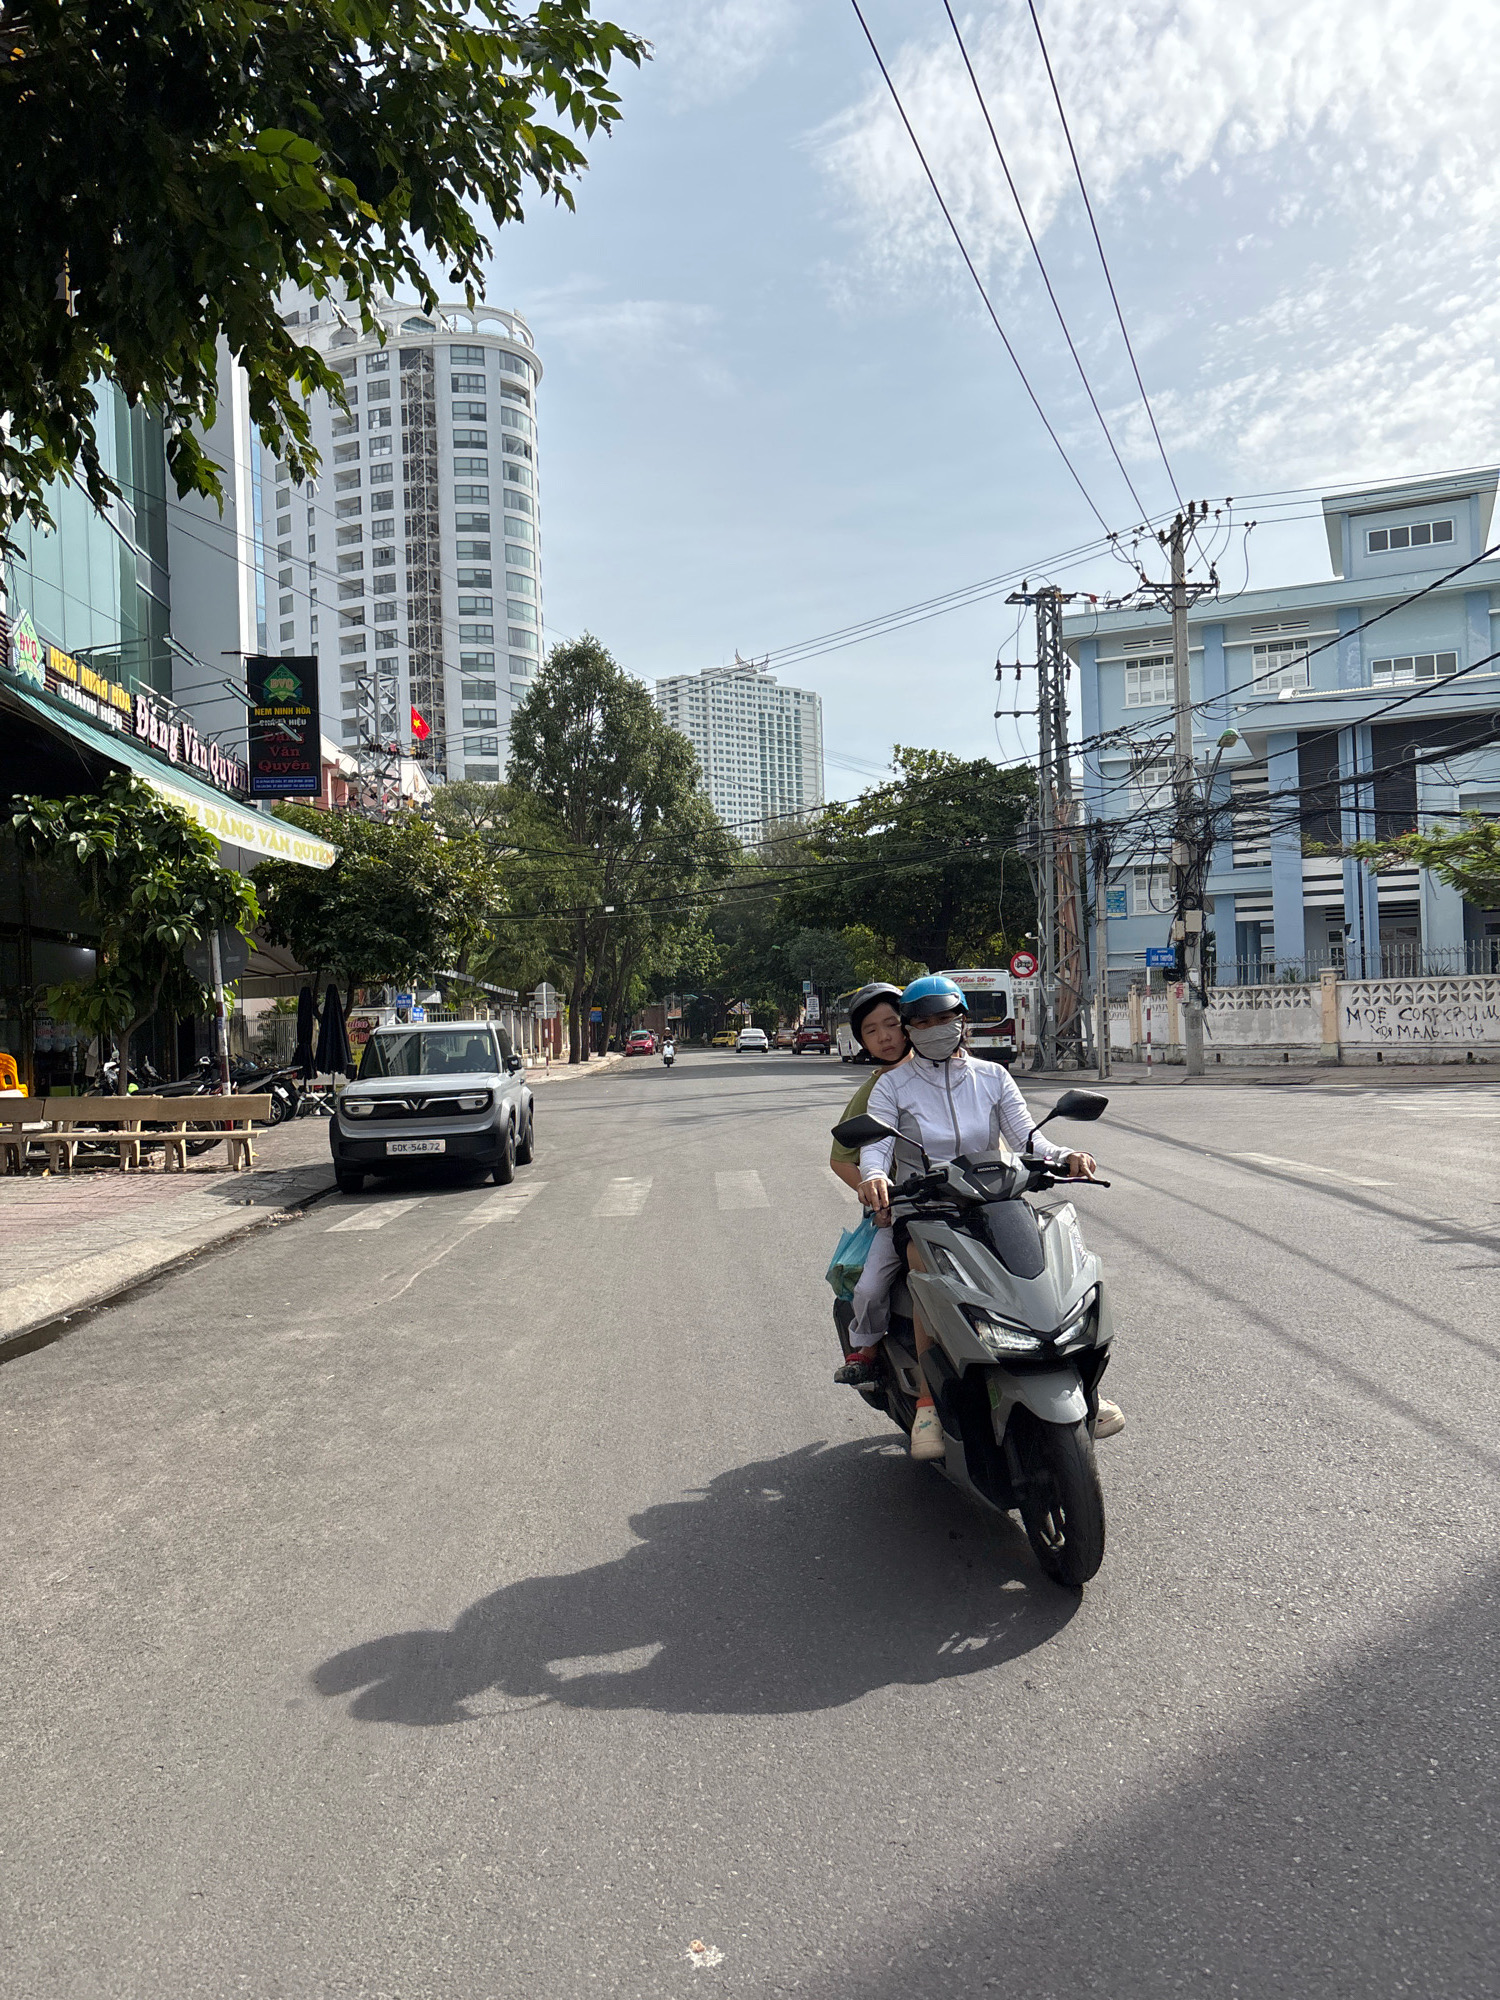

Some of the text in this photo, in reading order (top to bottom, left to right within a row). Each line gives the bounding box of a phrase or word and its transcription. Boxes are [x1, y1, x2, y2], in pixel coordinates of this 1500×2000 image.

[50, 645, 77, 681] NEM
[81, 664, 108, 700] NINH
[111, 682, 131, 713] HÒA
[60, 683, 123, 731] CHÁNH HIỆU
[254, 705, 312, 716] NEM NINH HÒA
[288, 718, 307, 727] HIỆU
[182, 723, 209, 772] Văn
[269, 745, 300, 757] Văn
[258, 760, 311, 774] Quyên
[205, 807, 255, 842] ĐẶNG
[258, 827, 291, 853] VĂN
[294, 840, 334, 865] QUYÊN
[977, 1165, 1000, 1173] HONDA
